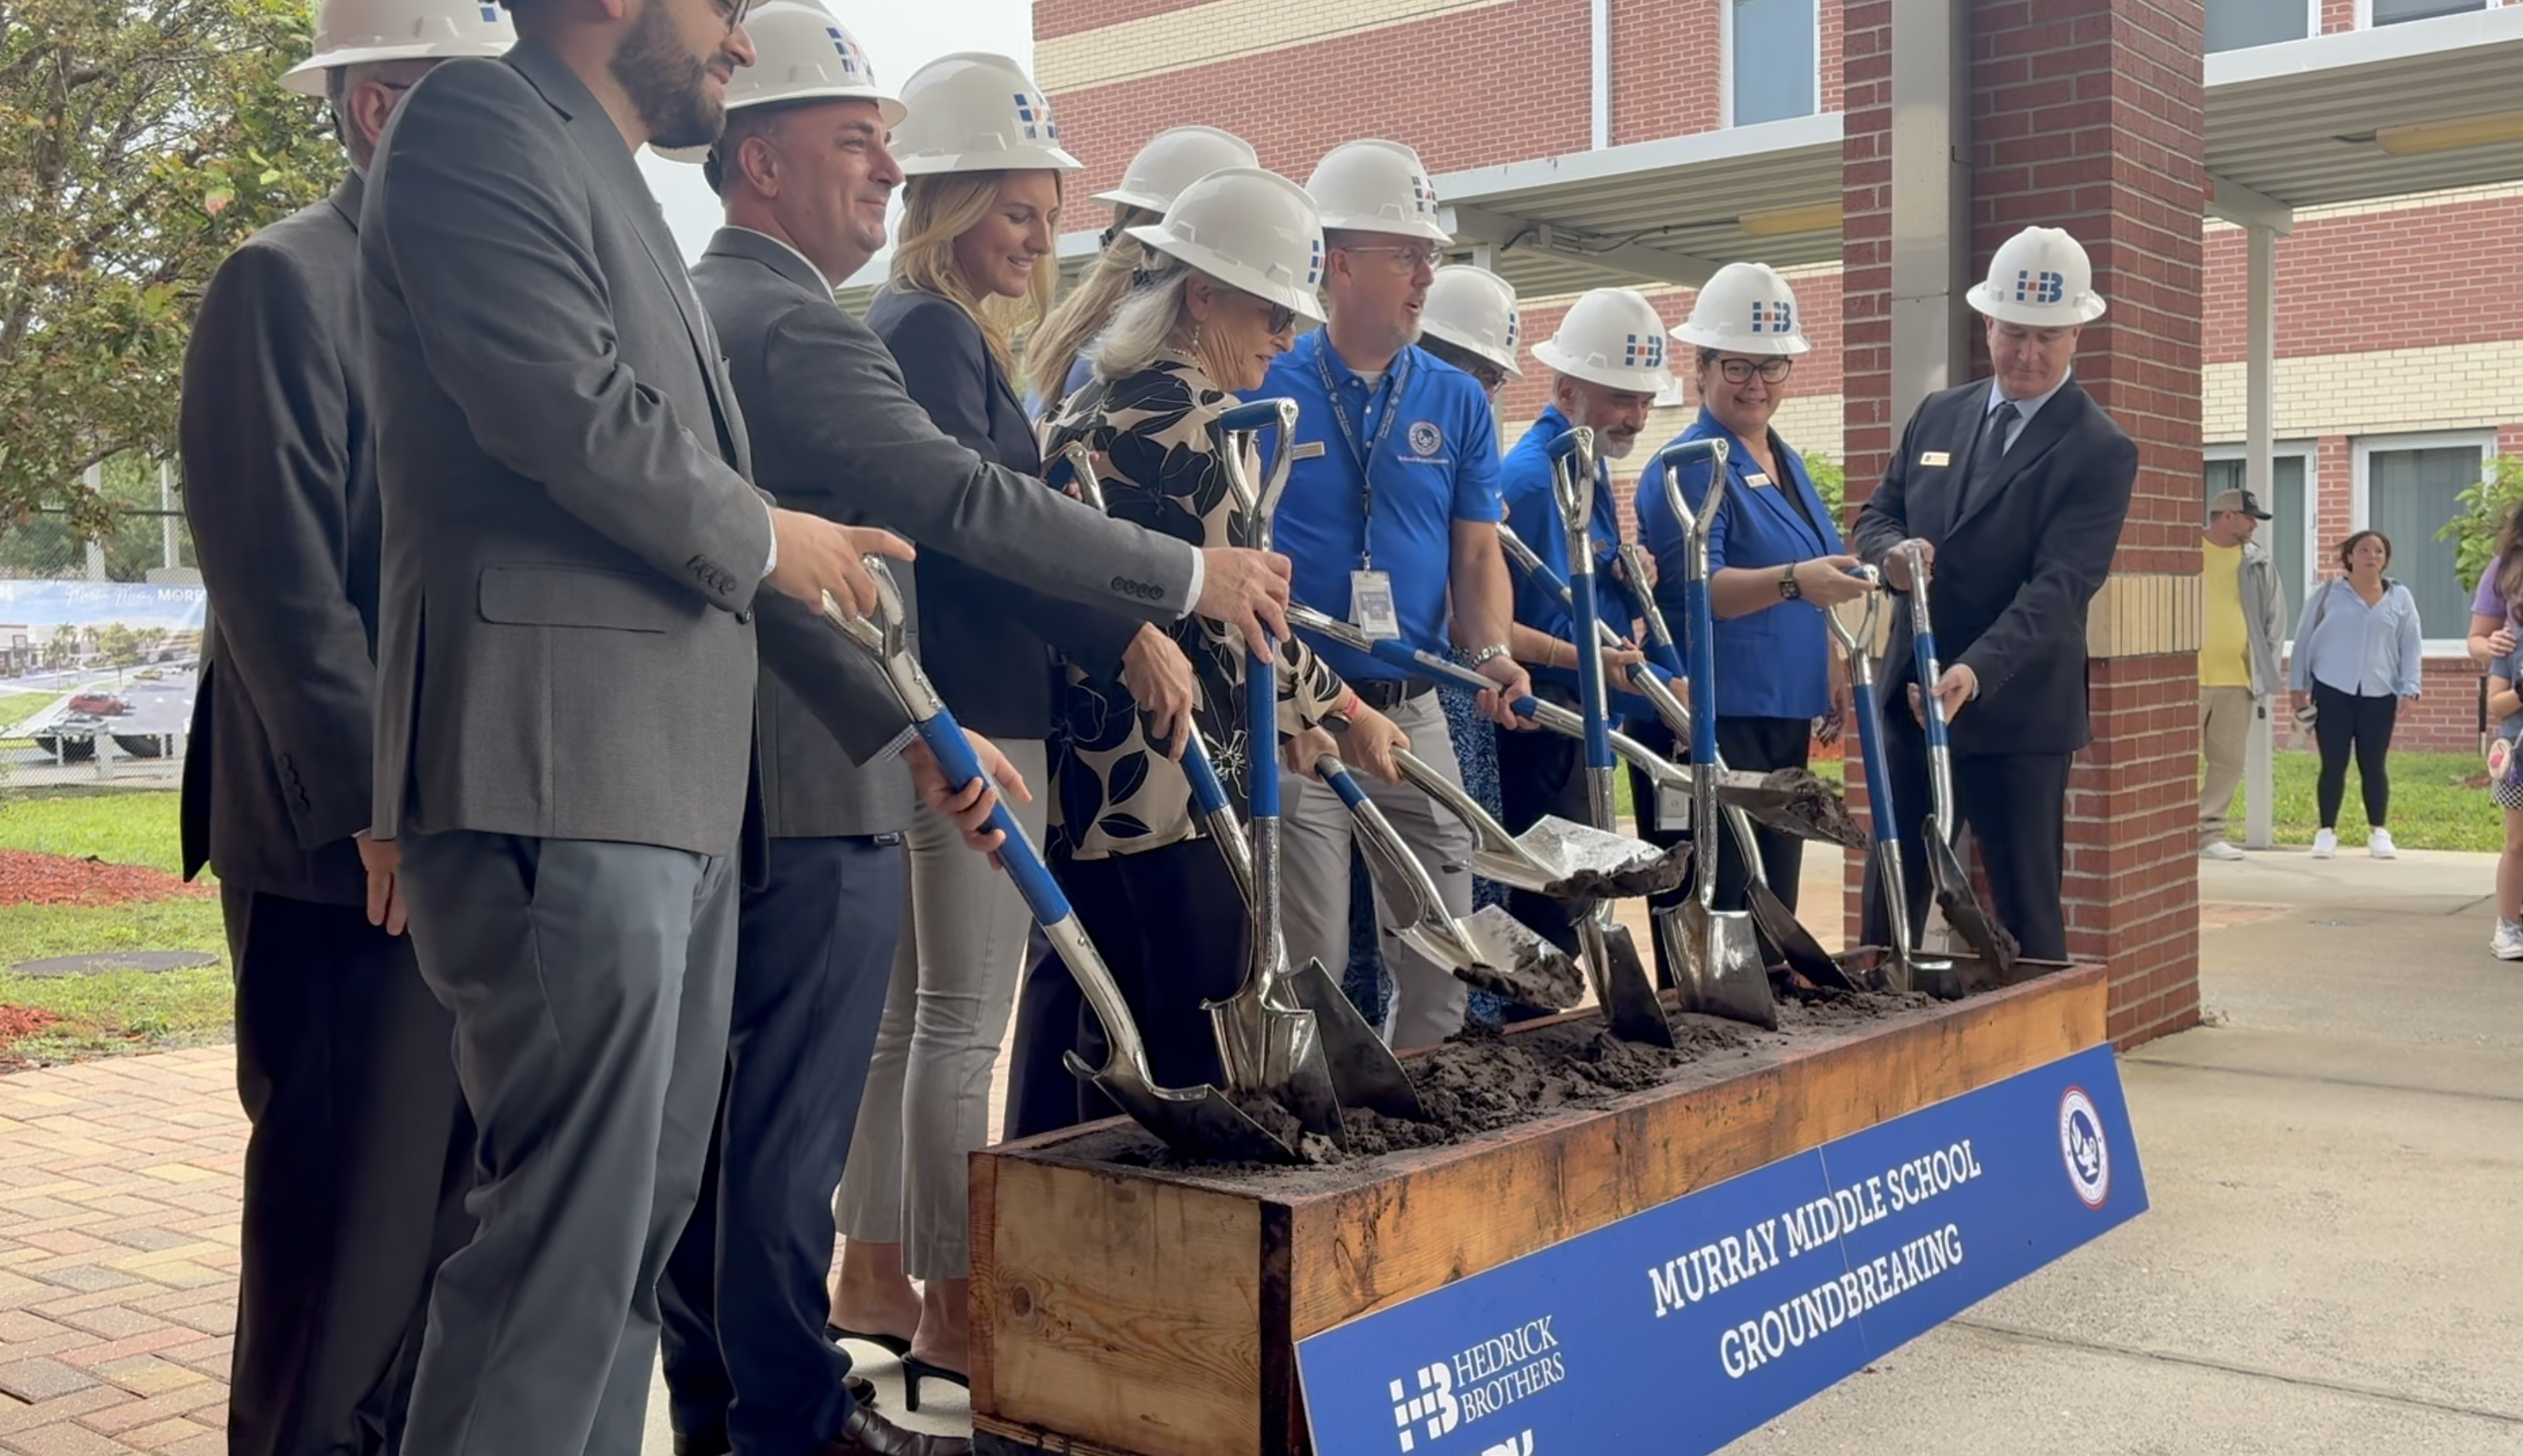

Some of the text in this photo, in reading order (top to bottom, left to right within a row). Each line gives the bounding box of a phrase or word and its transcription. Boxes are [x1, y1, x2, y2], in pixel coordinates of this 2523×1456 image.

[1752, 301, 1791, 333] HB
[2015, 270, 2065, 303] HB
[1625, 334, 1663, 368] HB
[1648, 1219, 1781, 1318] MURRAY
[1781, 1175, 1888, 1258] MIDDLE
[1887, 1139, 1982, 1211] SCHOOL
[1720, 1223, 1964, 1379] GROUNDBREAKING
[1451, 1314, 1559, 1388] HEDRICK
[1460, 1351, 1565, 1424] BROTHERS
[1388, 1362, 1460, 1454] HB
